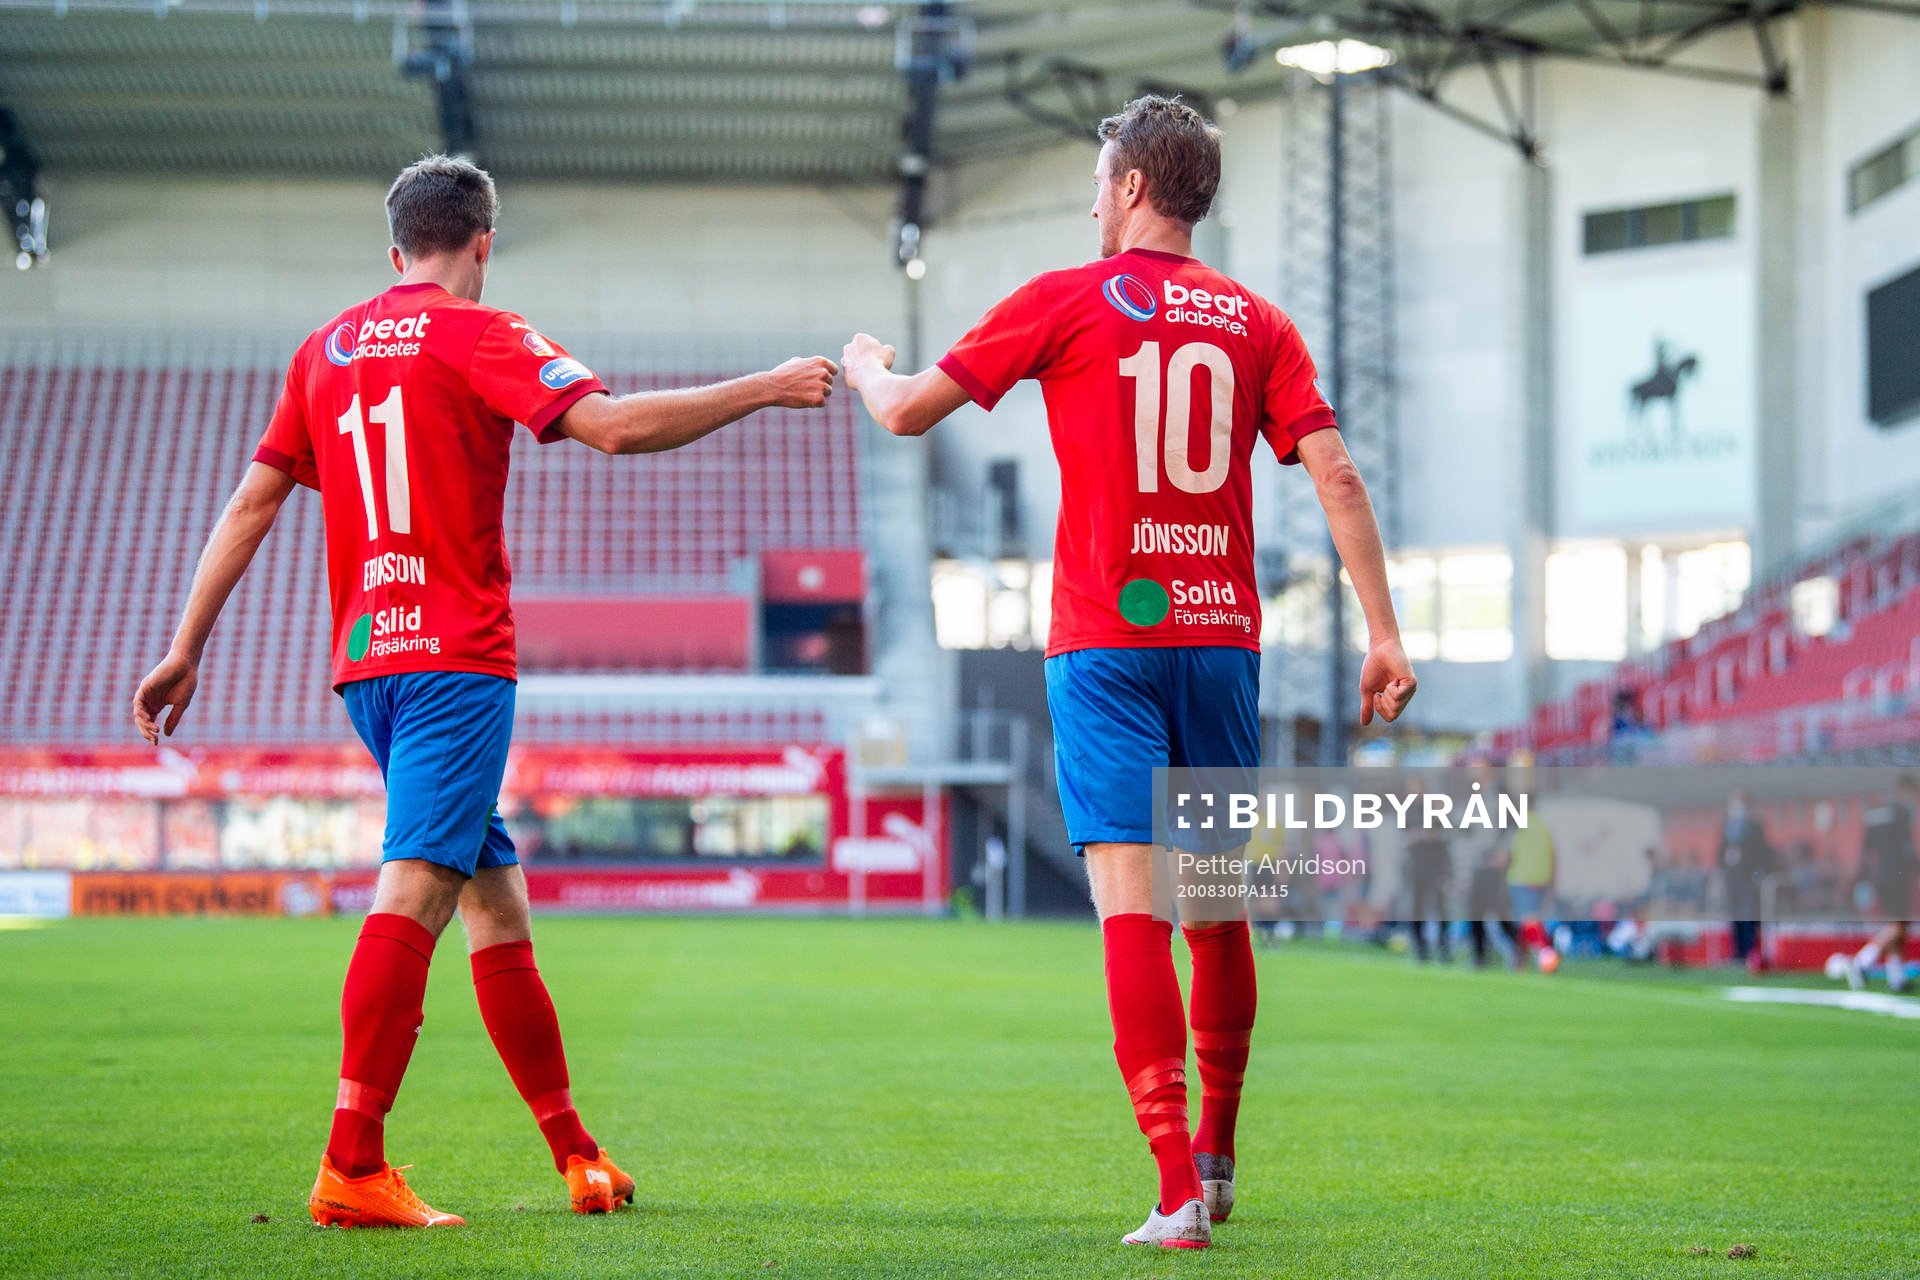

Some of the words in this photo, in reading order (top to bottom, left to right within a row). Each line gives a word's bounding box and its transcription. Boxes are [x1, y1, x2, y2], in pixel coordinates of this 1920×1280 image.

[1163, 279, 1249, 322] beat
[357, 311, 432, 343] beat
[1165, 306, 1248, 337] diabetes
[353, 339, 421, 361] diabetes
[1119, 340, 1235, 494] 10
[337, 385, 411, 542] 11
[1131, 518, 1229, 557] JÖNSSON
[1171, 579, 1237, 606] Solid
[1174, 609, 1252, 633] Försäkring
[370, 634, 441, 658] Försäkring
